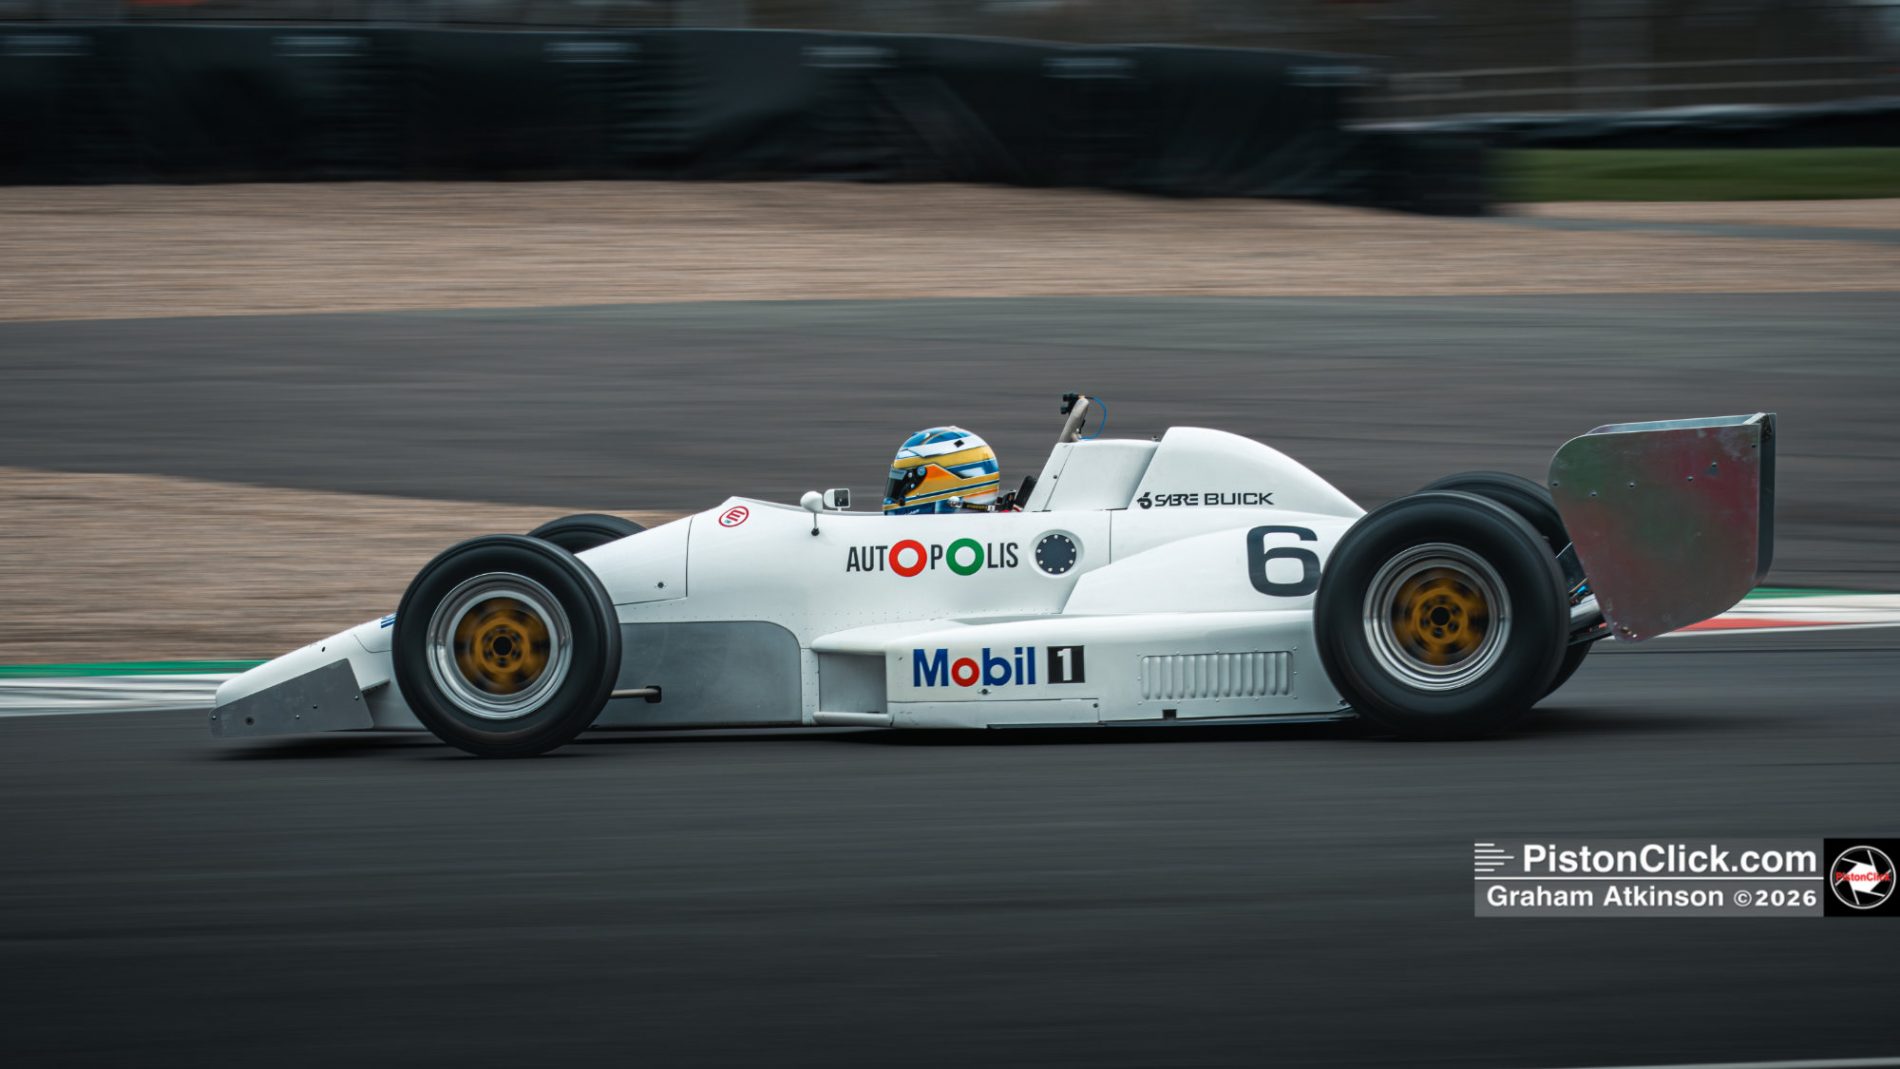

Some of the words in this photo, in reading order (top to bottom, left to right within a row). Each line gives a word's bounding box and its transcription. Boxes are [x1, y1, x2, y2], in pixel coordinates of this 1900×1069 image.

[1154, 494, 1198, 507] SABRE
[1204, 493, 1274, 505] BUICK
[846, 538, 1019, 577] AUTOPOLIS
[1246, 525, 1321, 597] 6
[913, 646, 1036, 688] Mobil
[1055, 647, 1073, 682] 1
